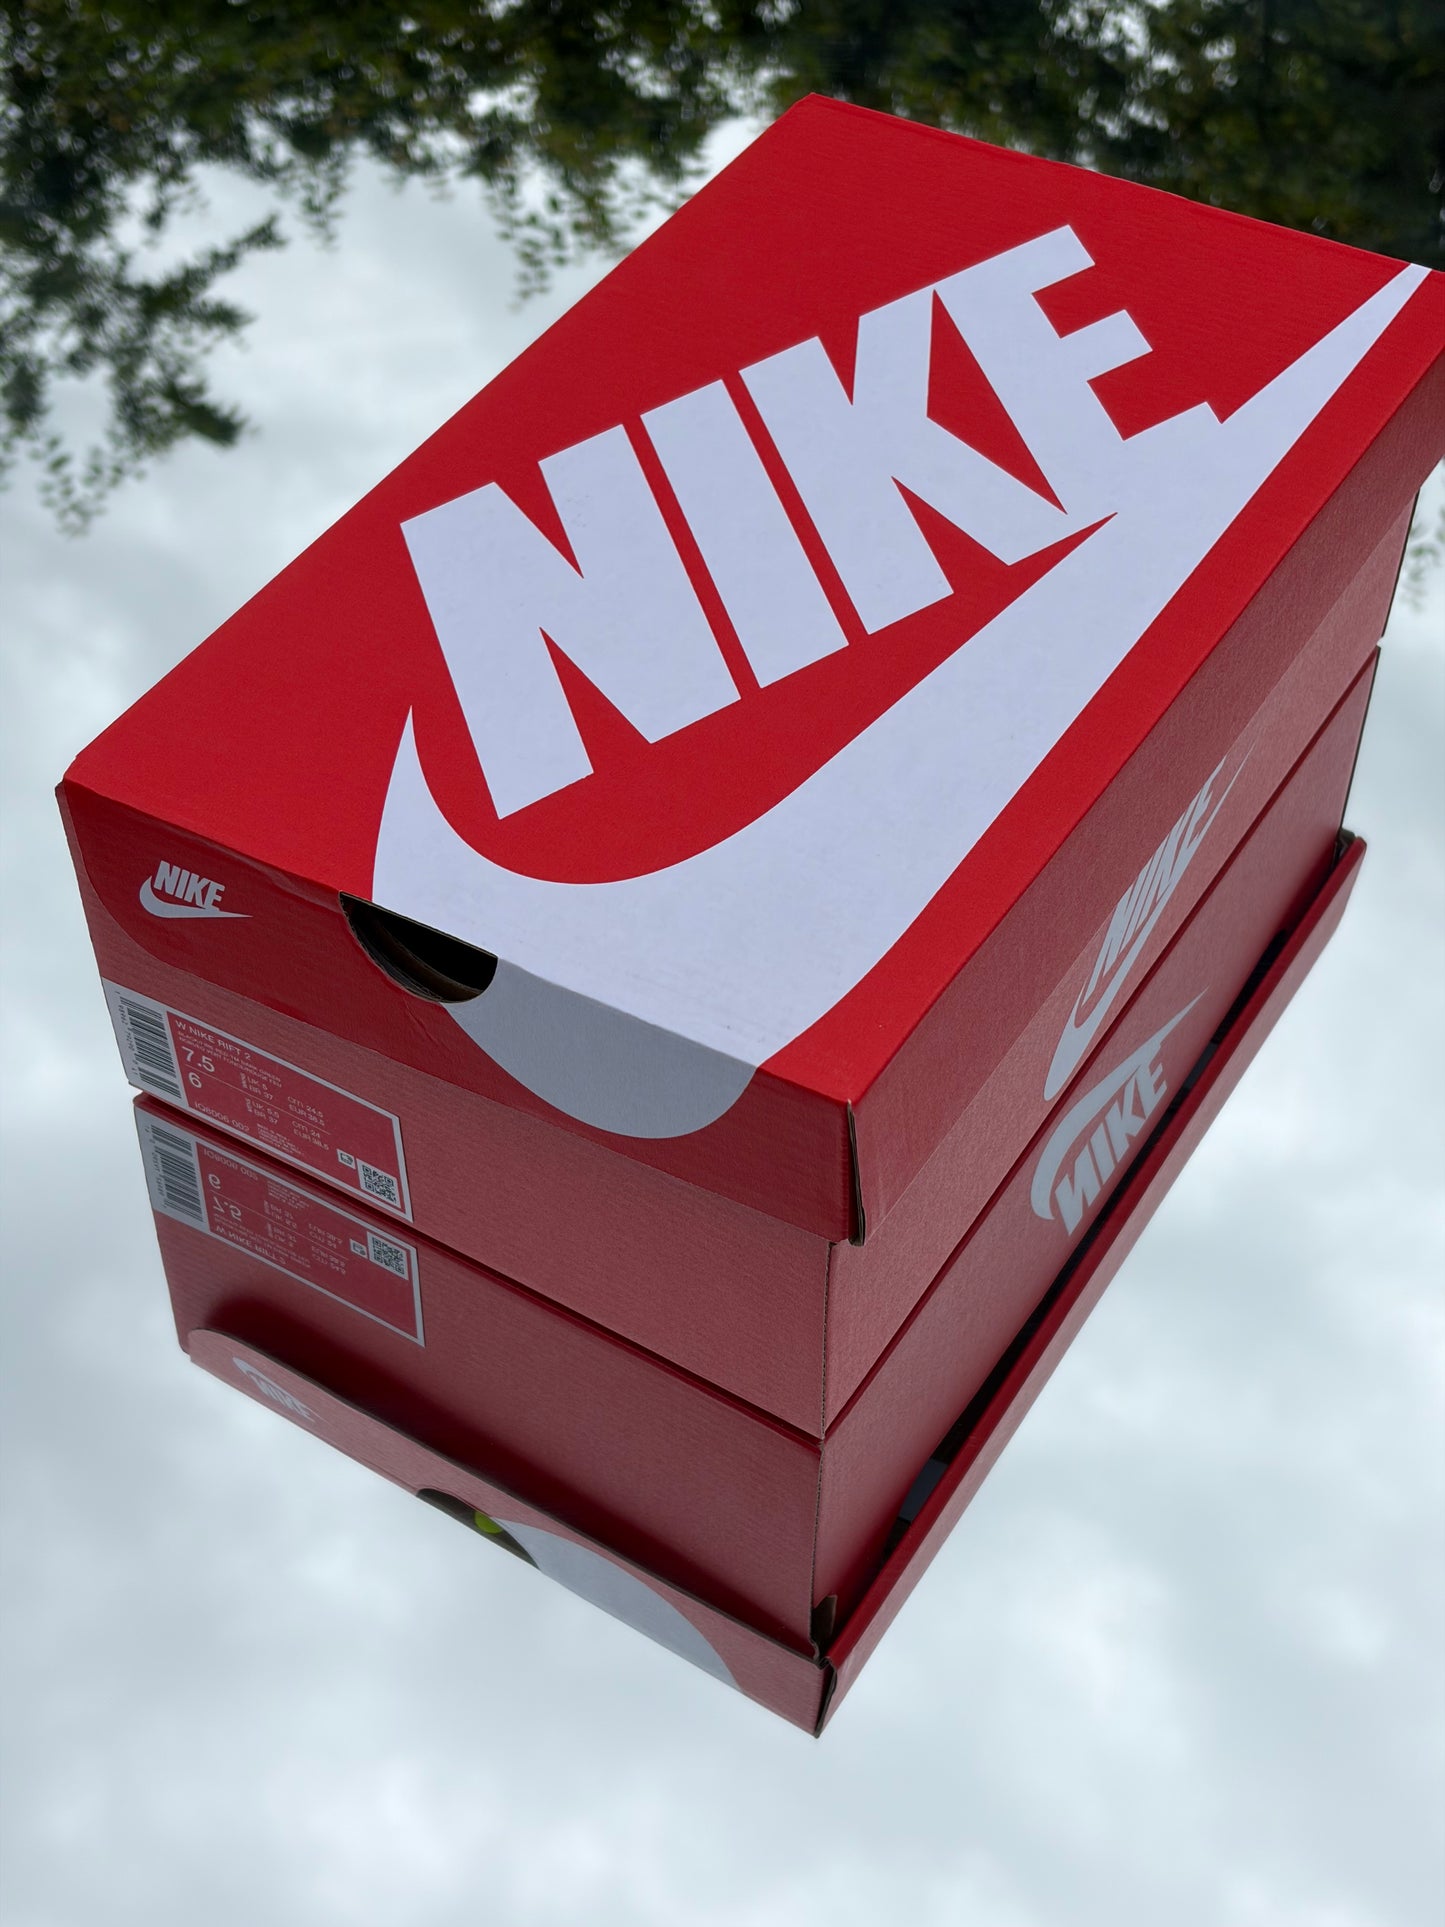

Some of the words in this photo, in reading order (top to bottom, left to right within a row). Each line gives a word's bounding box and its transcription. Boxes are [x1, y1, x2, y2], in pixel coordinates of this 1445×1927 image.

[400, 224, 1240, 818] NIKE
[153, 860, 226, 911] NIKE
[1050, 760, 1226, 1005] NIKE
[175, 1020, 186, 1030] W
[188, 1026, 215, 1043] NIKE
[217, 1039, 241, 1056] RIFT
[243, 1052, 252, 1061] 2
[181, 1046, 216, 1073] 7.5
[187, 1071, 202, 1089] 6
[247, 1077, 259, 1087] UK
[248, 1085, 261, 1095] BR
[263, 1092, 273, 1101] 37
[252, 1101, 264, 1111] UK
[286, 1096, 303, 1108] cm
[306, 1105, 323, 1118] 24.5
[288, 1104, 306, 1117] EUR
[253, 1109, 265, 1119] BR
[268, 1116, 278, 1125] 37
[291, 1120, 308, 1133] cm
[310, 1130, 320, 1139] 24
[292, 1129, 311, 1142] EUR
